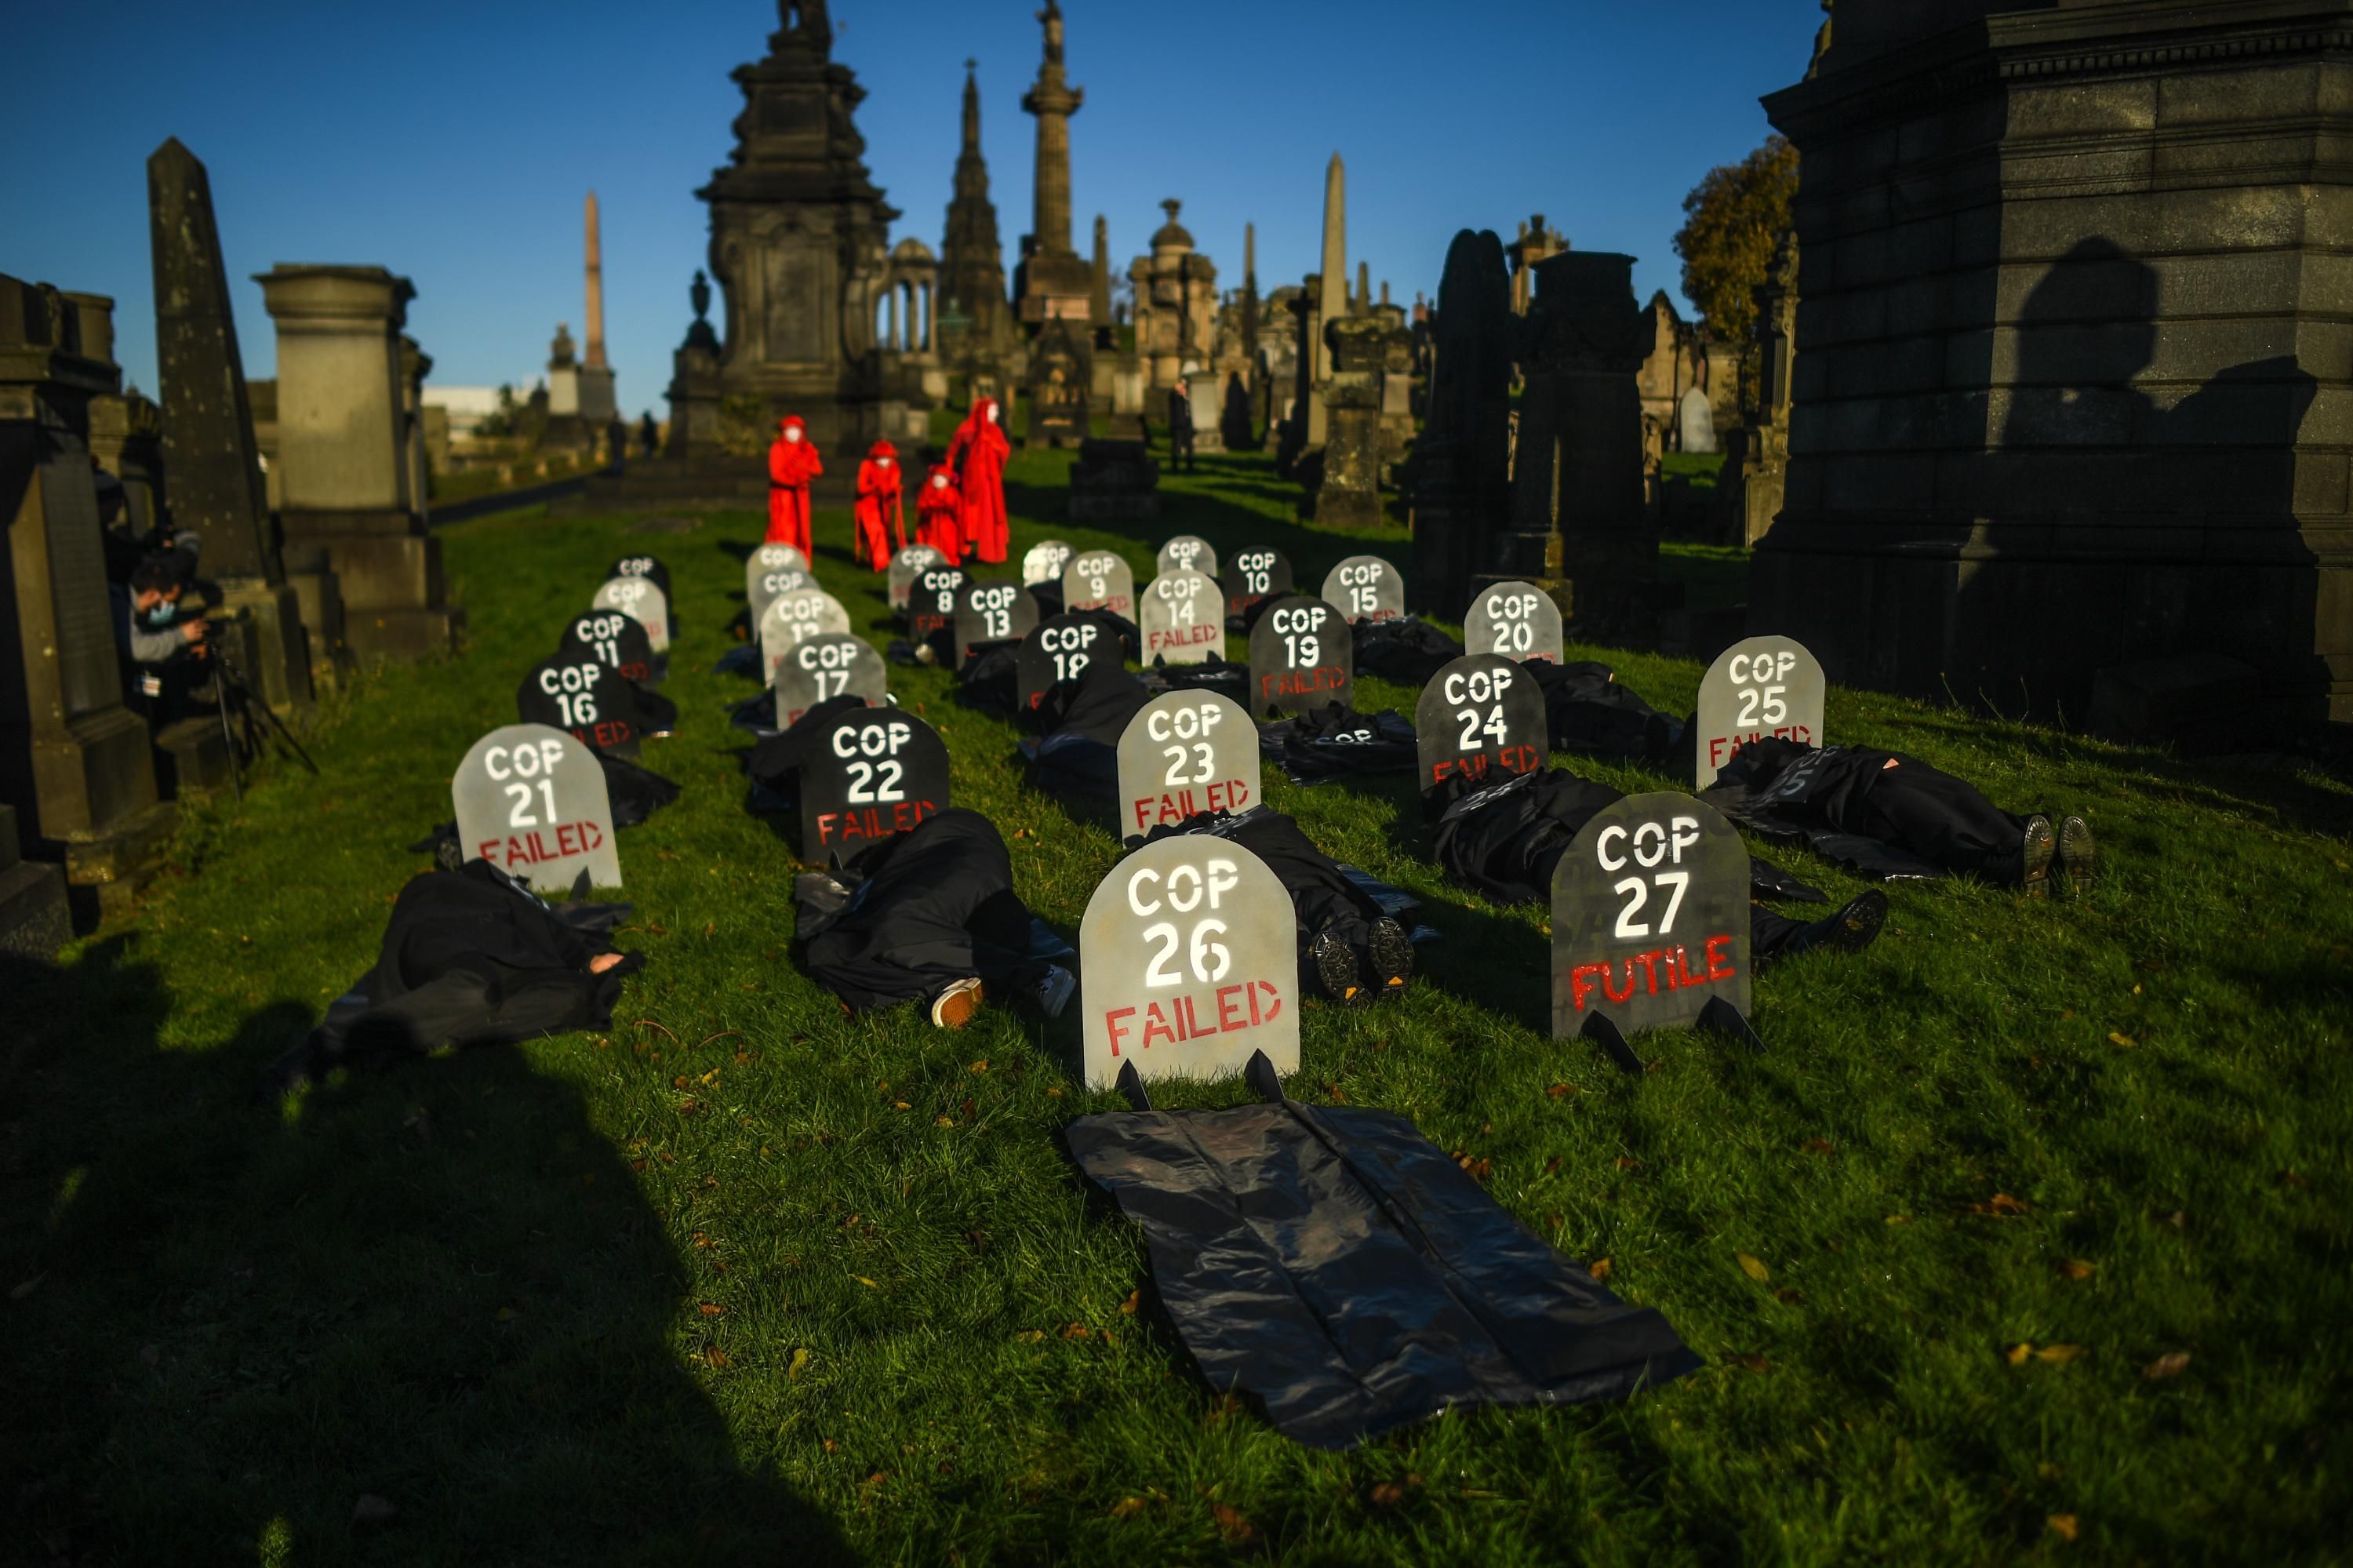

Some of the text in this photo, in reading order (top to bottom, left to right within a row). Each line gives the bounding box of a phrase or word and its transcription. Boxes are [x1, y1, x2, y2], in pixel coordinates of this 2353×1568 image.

[760, 548, 795, 566] COP
[901, 549, 935, 566] COP
[1037, 547, 1070, 564] OP
[1169, 541, 1201, 558] COP
[1238, 552, 1275, 572] COP
[620, 558, 653, 575] COP
[924, 571, 962, 591] COP
[1077, 556, 1115, 577] COP
[1339, 562, 1383, 586] COP
[607, 582, 646, 604] COP
[764, 572, 804, 593] COP
[1090, 577, 1107, 599] 9
[1158, 577, 1202, 599] COP
[1246, 571, 1270, 594] 10
[778, 597, 824, 622] COP
[937, 591, 953, 613] 8
[970, 586, 1016, 612] COP
[1168, 599, 1195, 628] 14
[1349, 586, 1378, 614] 15
[1486, 594, 1538, 620] COP
[576, 615, 624, 642] COP
[983, 609, 1011, 638] 13
[1272, 607, 1326, 634] COP
[1041, 624, 1097, 652] COP
[1149, 623, 1218, 651] FAILED
[1284, 635, 1319, 668] 19
[1493, 621, 1533, 653] 20
[593, 639, 620, 668] 11
[798, 642, 857, 670] COP
[1729, 651, 1795, 685] COP
[540, 664, 600, 694] COP
[813, 670, 850, 703] 17
[1261, 666, 1346, 699] FAILED
[1444, 668, 1512, 706] COP
[556, 692, 598, 726] 16
[1737, 686, 1787, 728] 25
[1147, 704, 1222, 742] COP
[1456, 704, 1507, 751] 24
[832, 722, 911, 758] COP
[485, 739, 564, 781] COP
[1162, 742, 1215, 786] 23
[846, 759, 904, 804] 22
[504, 778, 558, 828] 21
[1134, 779, 1249, 829] FAILED
[478, 820, 603, 867] FAILED
[1597, 816, 1700, 871] COP
[1127, 858, 1238, 917] COP
[1613, 871, 1689, 939] 27
[1142, 918, 1231, 988] 26
[1570, 934, 1736, 1012] FUTILE
[1105, 980, 1282, 1057] FAILED
